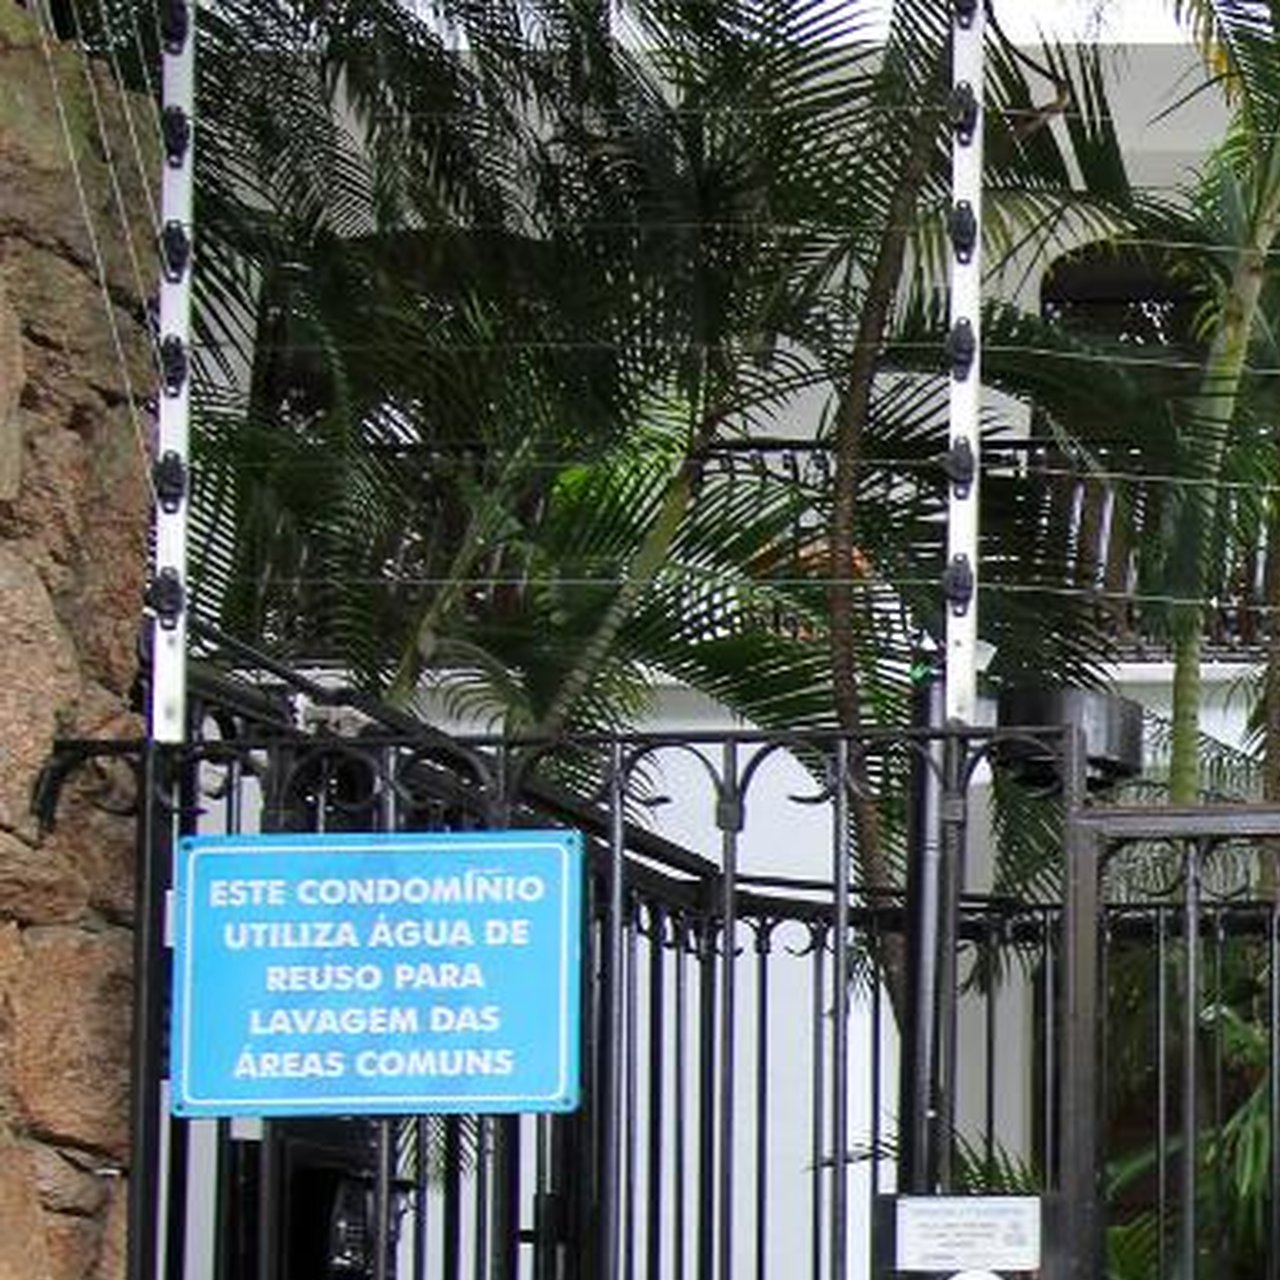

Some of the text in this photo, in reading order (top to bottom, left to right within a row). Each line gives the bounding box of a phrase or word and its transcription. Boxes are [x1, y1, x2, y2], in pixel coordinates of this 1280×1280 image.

[209, 878, 287, 907] ESTE
[224, 913, 529, 950] UTILIZA ÁGUA DE
[266, 963, 484, 992] REUSO PARA
[250, 1006, 500, 1035] LAVAGEM DAS
[234, 1044, 513, 1078] ÁREAS COMUNS
